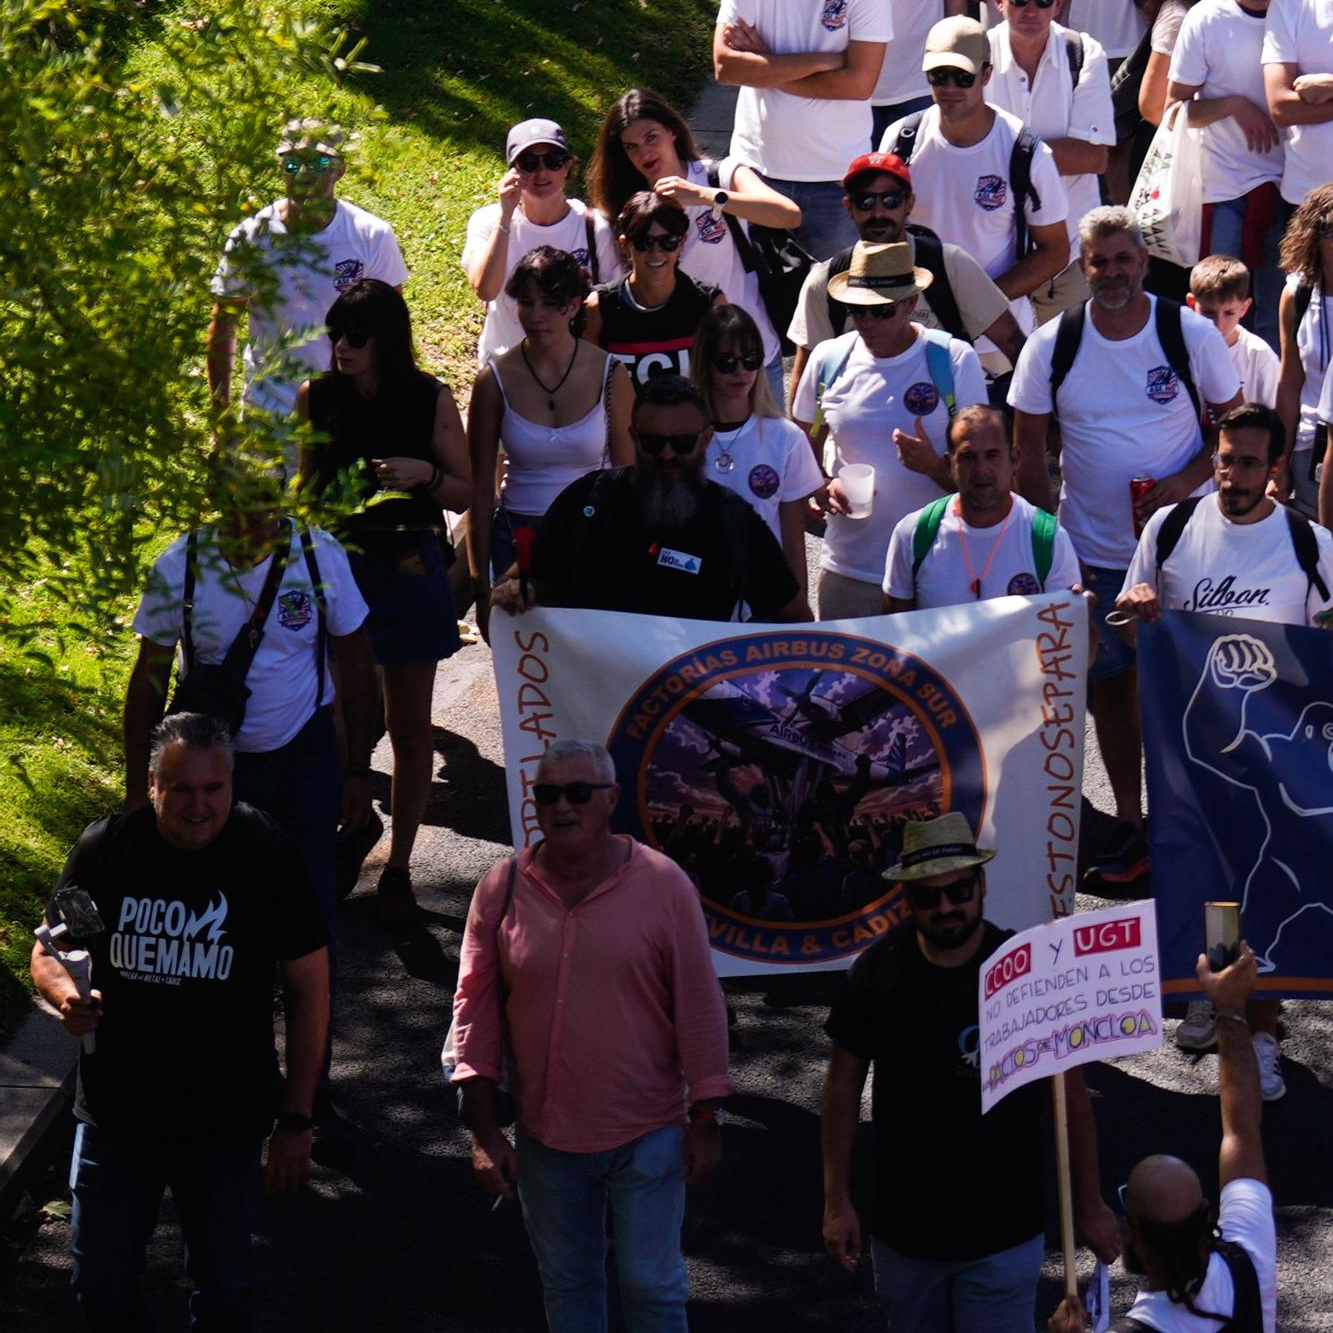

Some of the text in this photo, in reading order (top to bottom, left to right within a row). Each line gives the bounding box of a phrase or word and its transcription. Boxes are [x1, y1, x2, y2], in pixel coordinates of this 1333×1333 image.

[661, 554, 674, 565] NO
[626, 638, 959, 743] FACTORÍAS AIRBUS ZONA SUR
[117, 896, 187, 938] POCO
[109, 932, 235, 981] QUEMAMO
[801, 933, 823, 955] &
[985, 919, 1138, 997] CCOO Y UGT
[986, 954, 1156, 1023] NO DEFIENDEN A LOS
[983, 982, 1156, 1053] TRABAJADORES DESDE
[1053, 1010, 1155, 1057] MONCLOA
